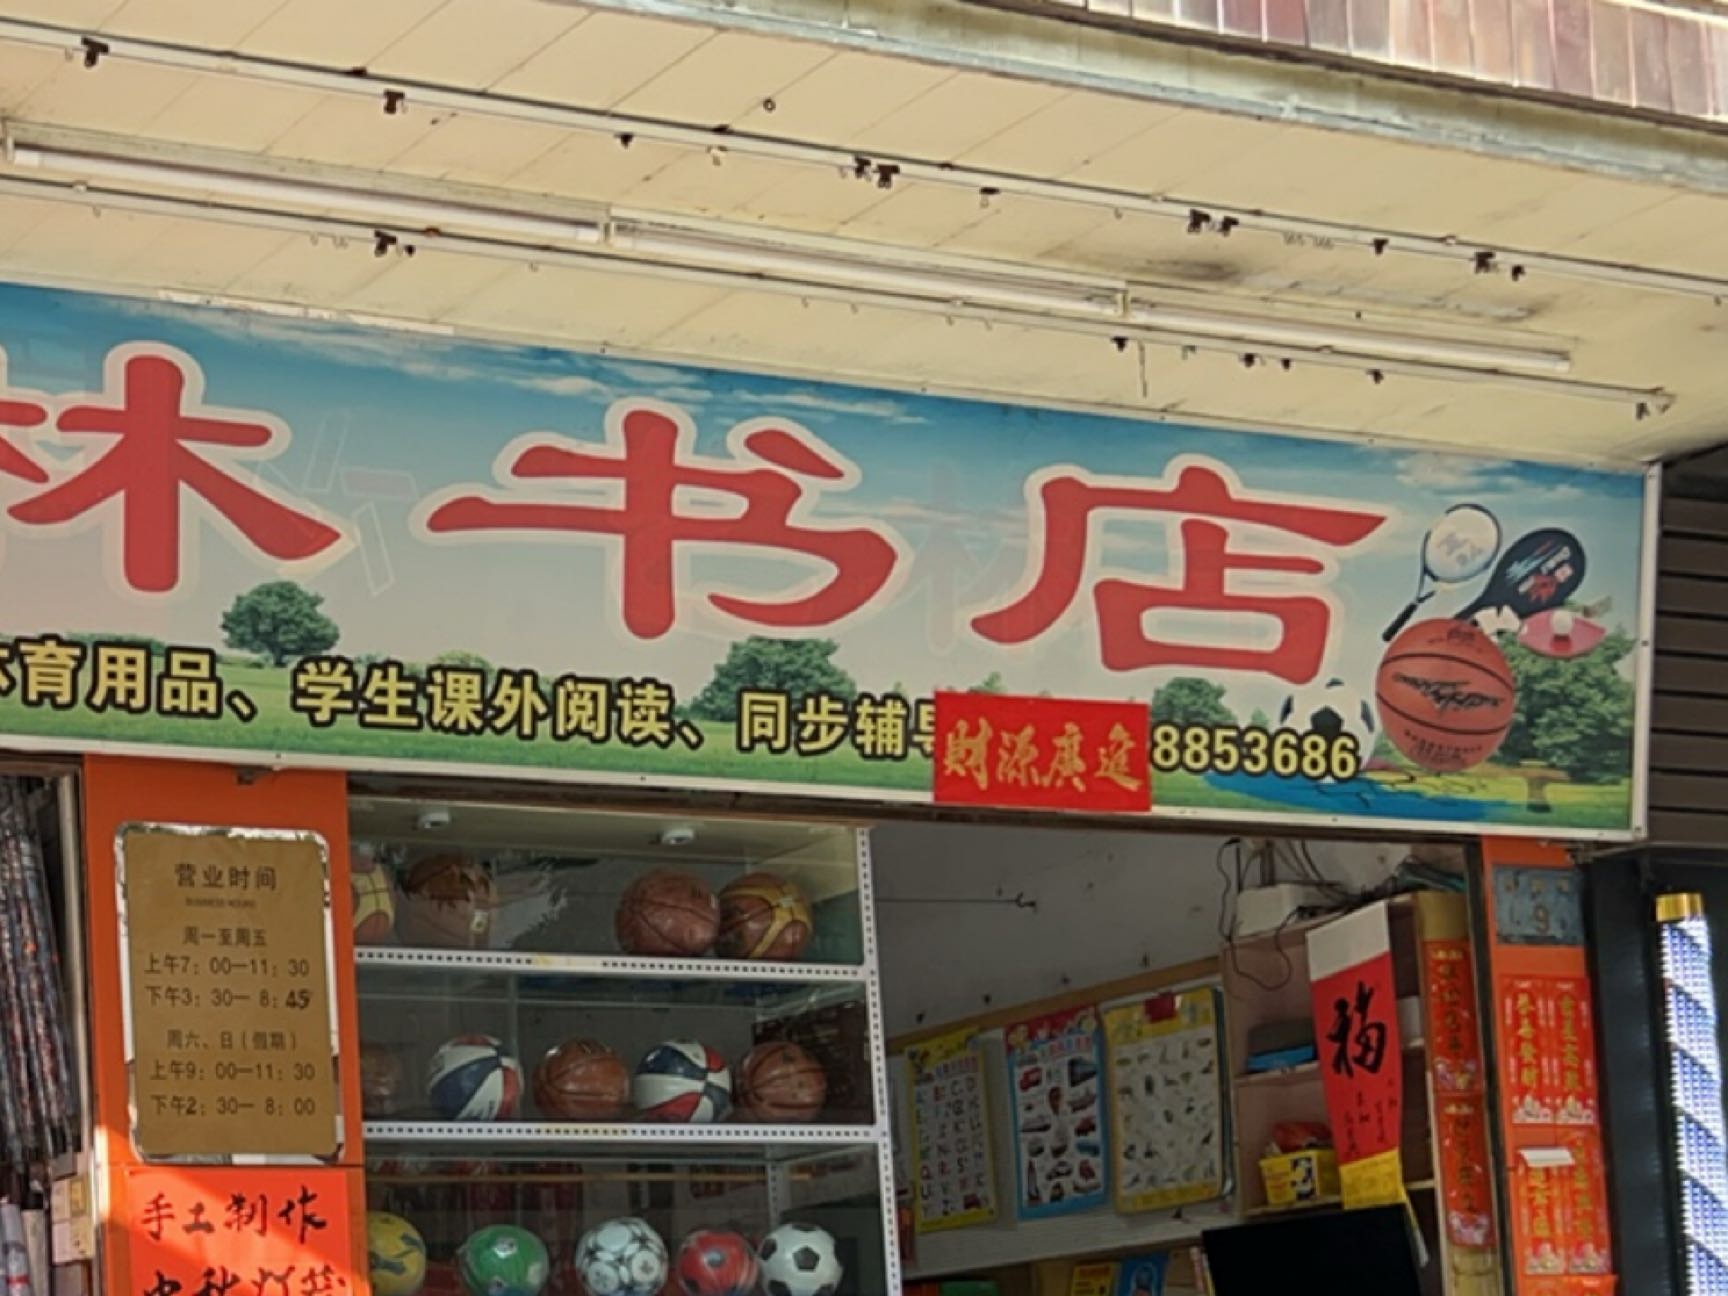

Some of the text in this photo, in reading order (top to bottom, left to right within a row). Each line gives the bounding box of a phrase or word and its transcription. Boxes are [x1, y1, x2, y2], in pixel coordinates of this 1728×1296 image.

[1151, 724, 1360, 780] 8853686
[174, 864, 277, 891] 营业时间
[181, 926, 267, 946] 周一至周五
[1326, 981, 1386, 1078] 福
